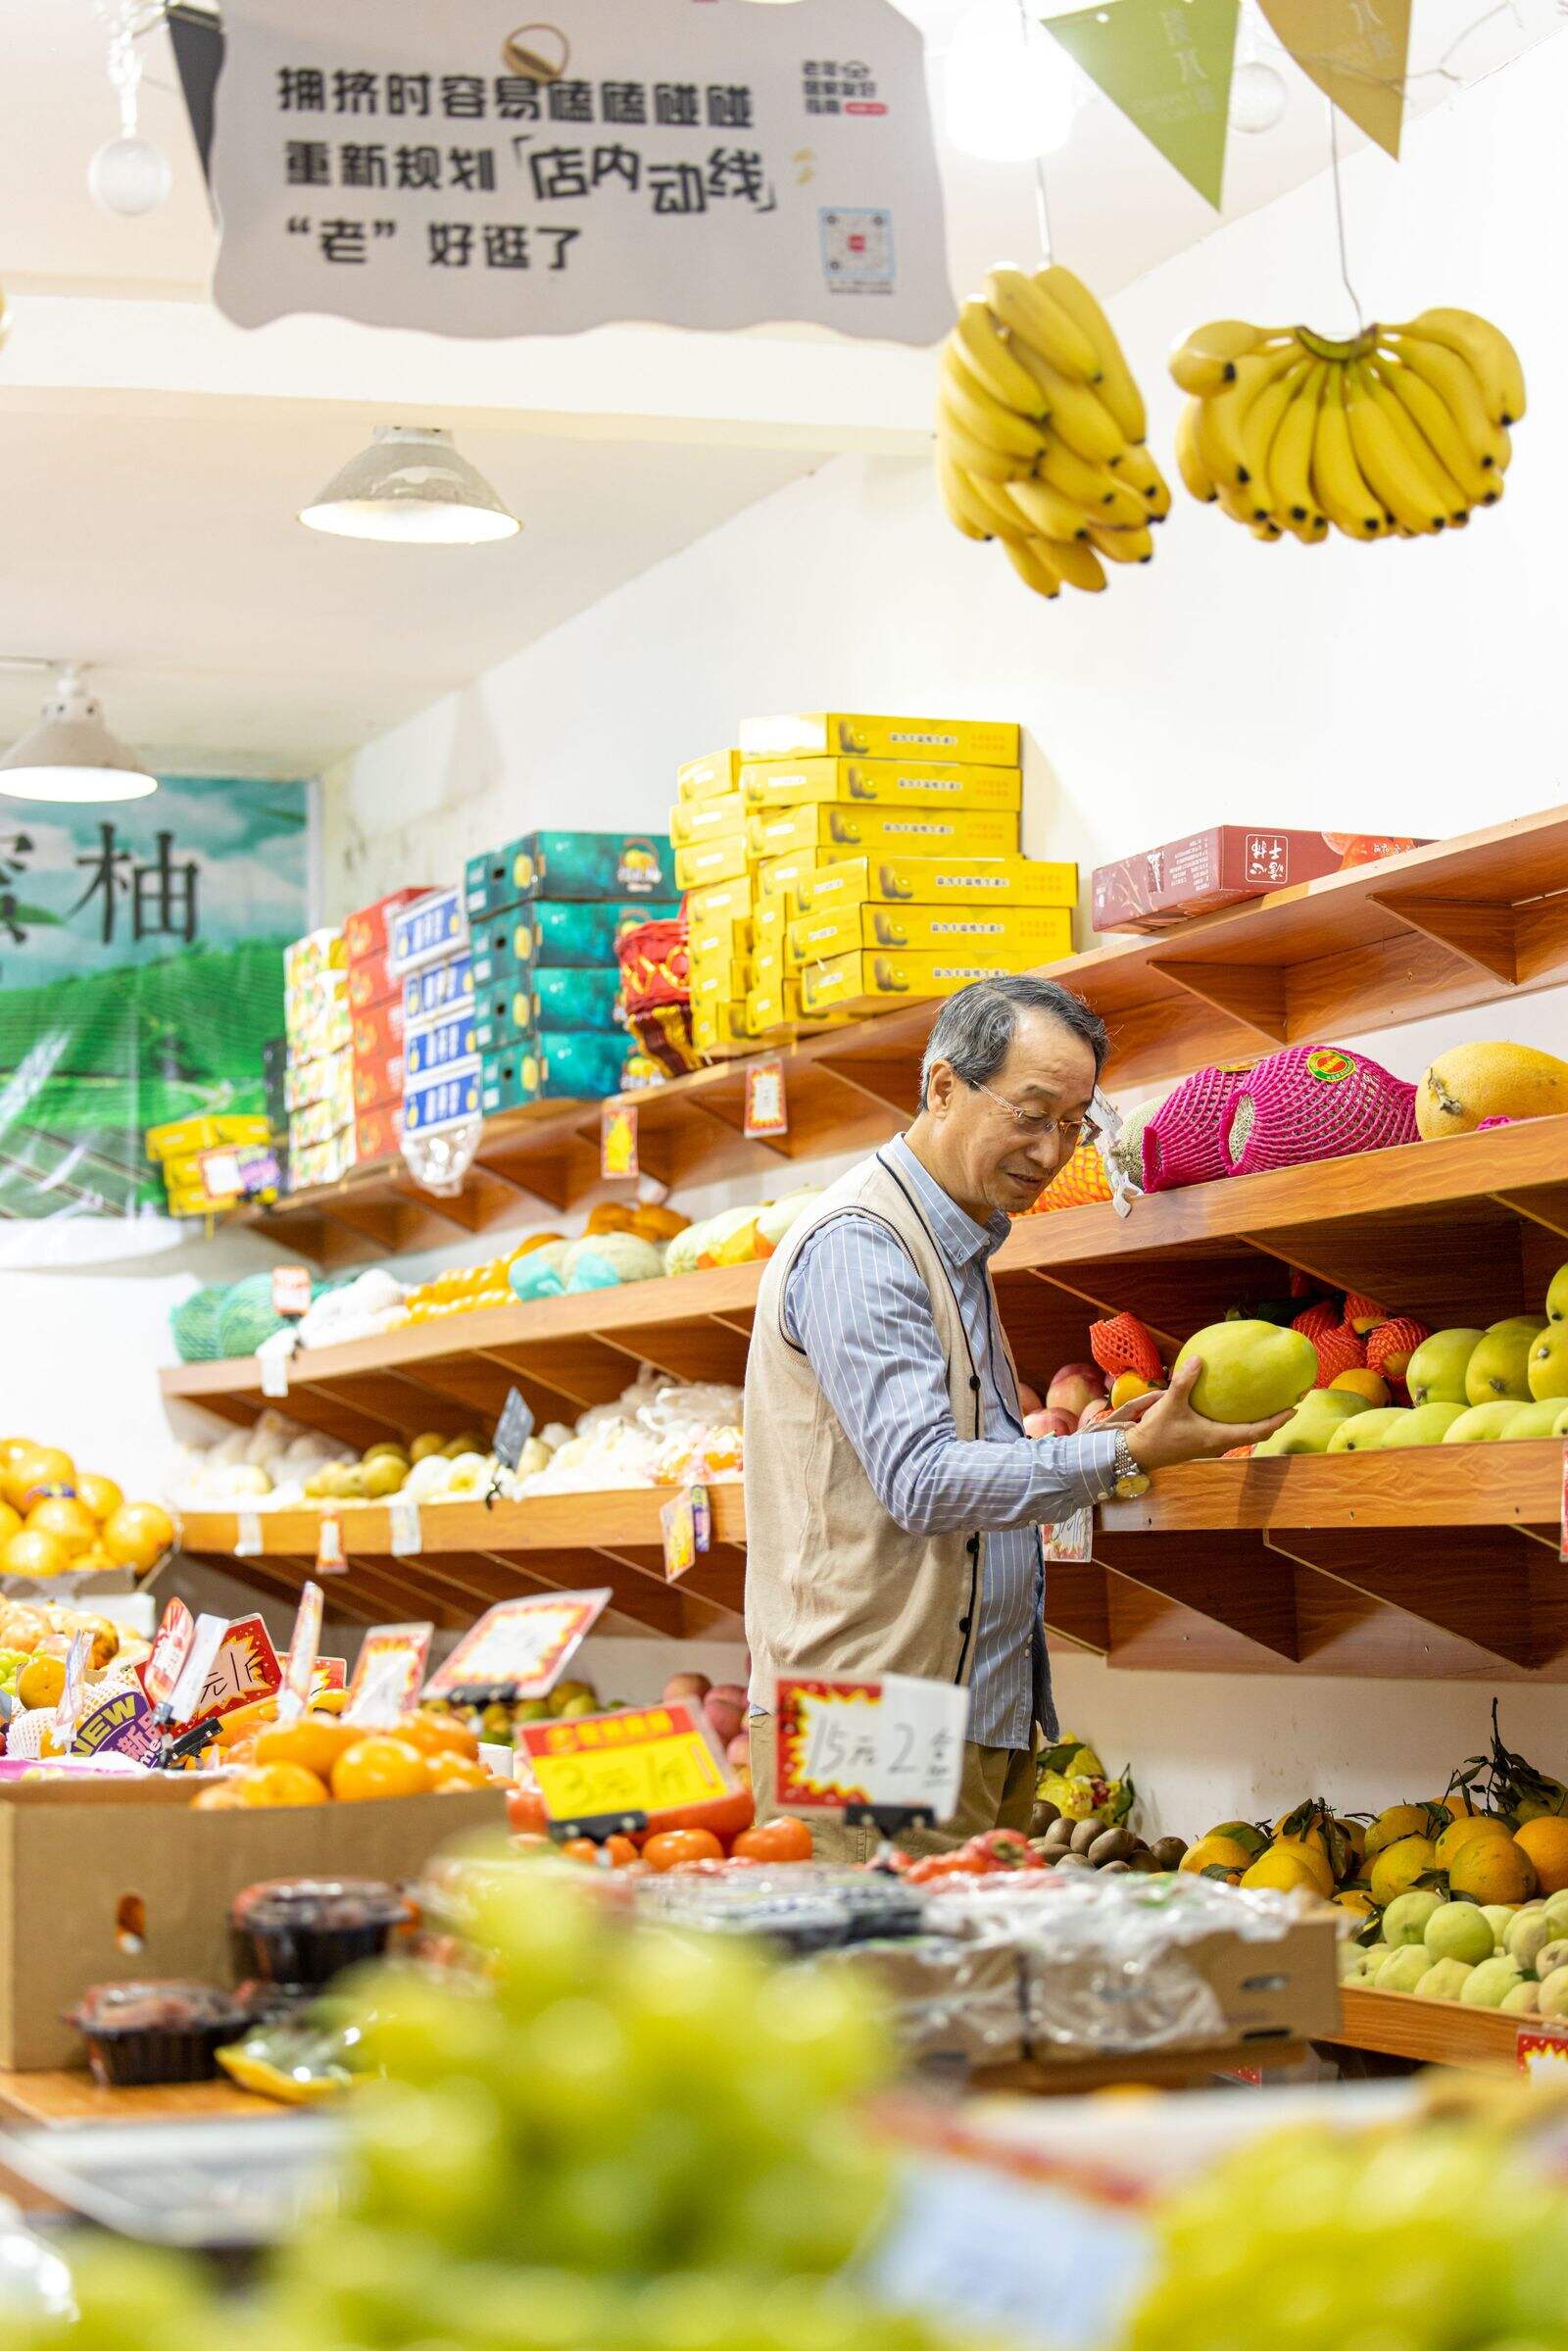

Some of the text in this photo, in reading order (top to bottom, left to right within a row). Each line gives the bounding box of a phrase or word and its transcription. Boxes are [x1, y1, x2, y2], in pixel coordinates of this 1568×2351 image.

[276, 67, 755, 128] 拥挤时容易磕磕碰碰
